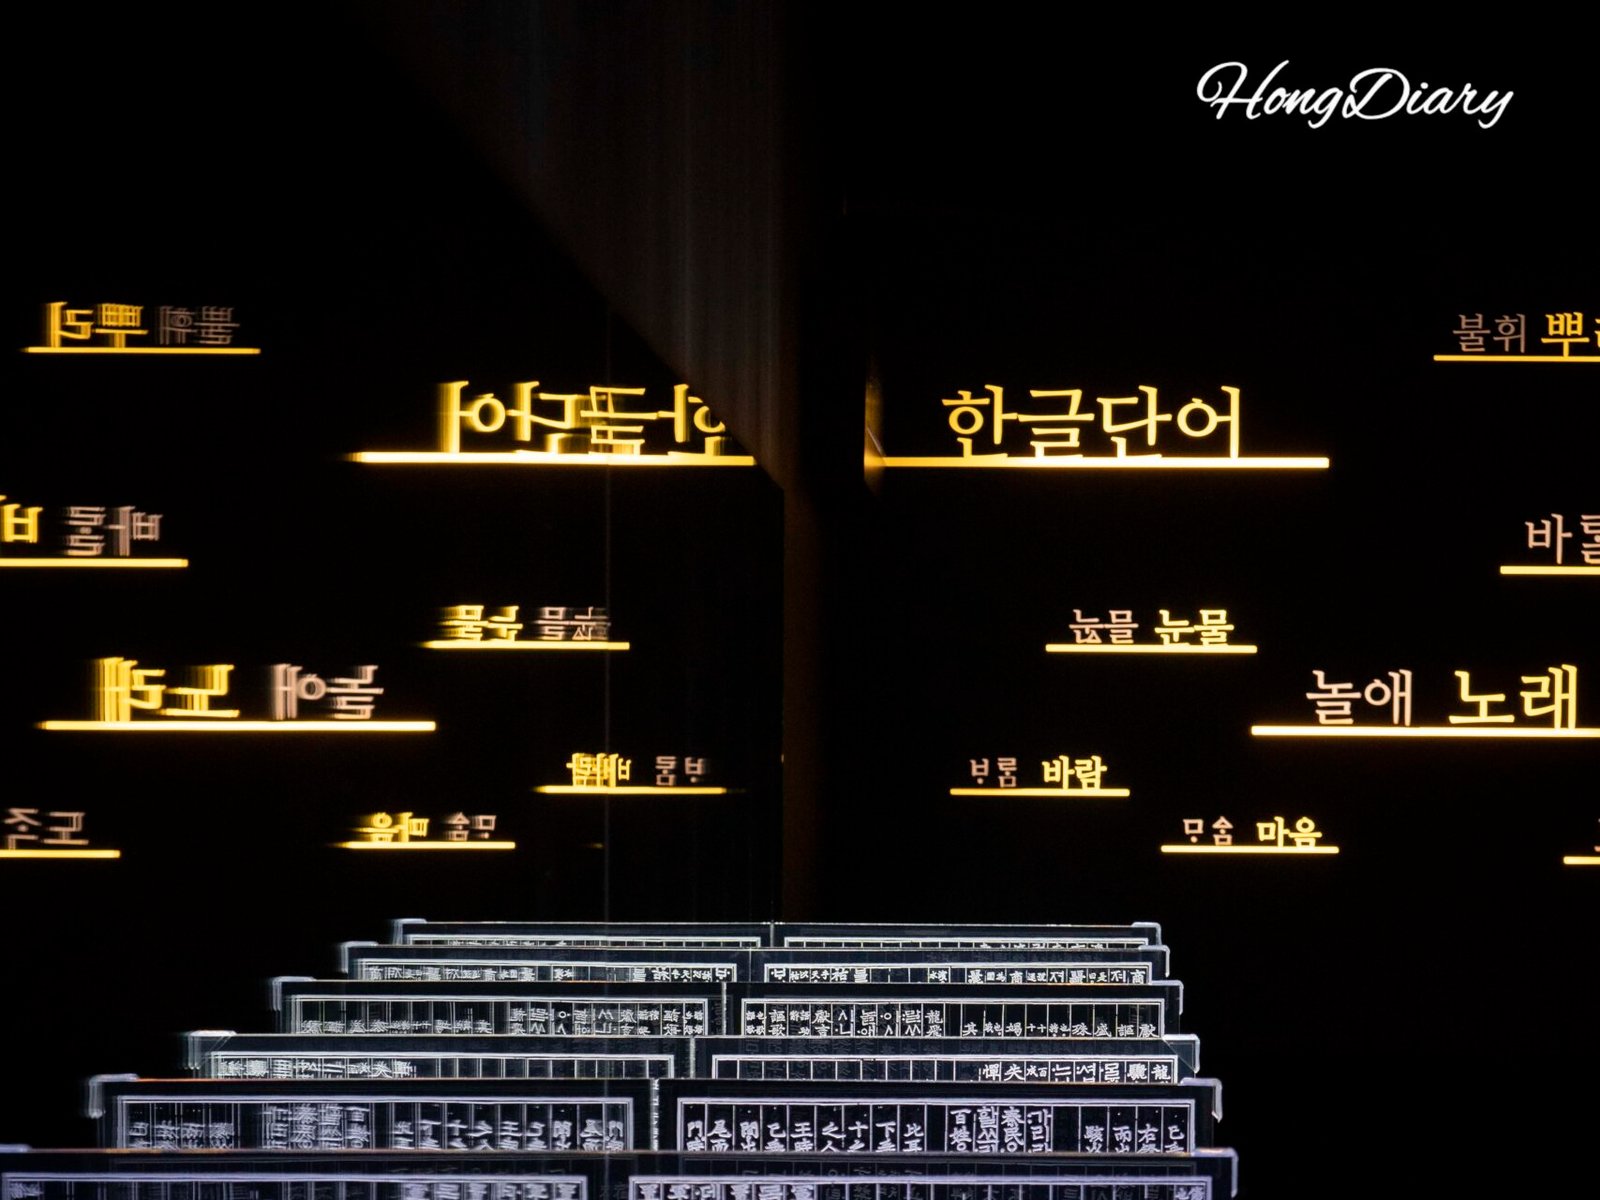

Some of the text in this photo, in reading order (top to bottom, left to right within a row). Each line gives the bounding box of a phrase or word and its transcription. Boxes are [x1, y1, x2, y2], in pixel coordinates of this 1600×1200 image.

[1453, 312, 1600, 357] 불휘 뿌
[942, 384, 1240, 459] 한글단어
[1154, 609, 1235, 647] 눈물
[1306, 663, 1577, 731] 놀애 노래
[1042, 755, 1107, 790] 바람
[1256, 816, 1322, 848] 마음
